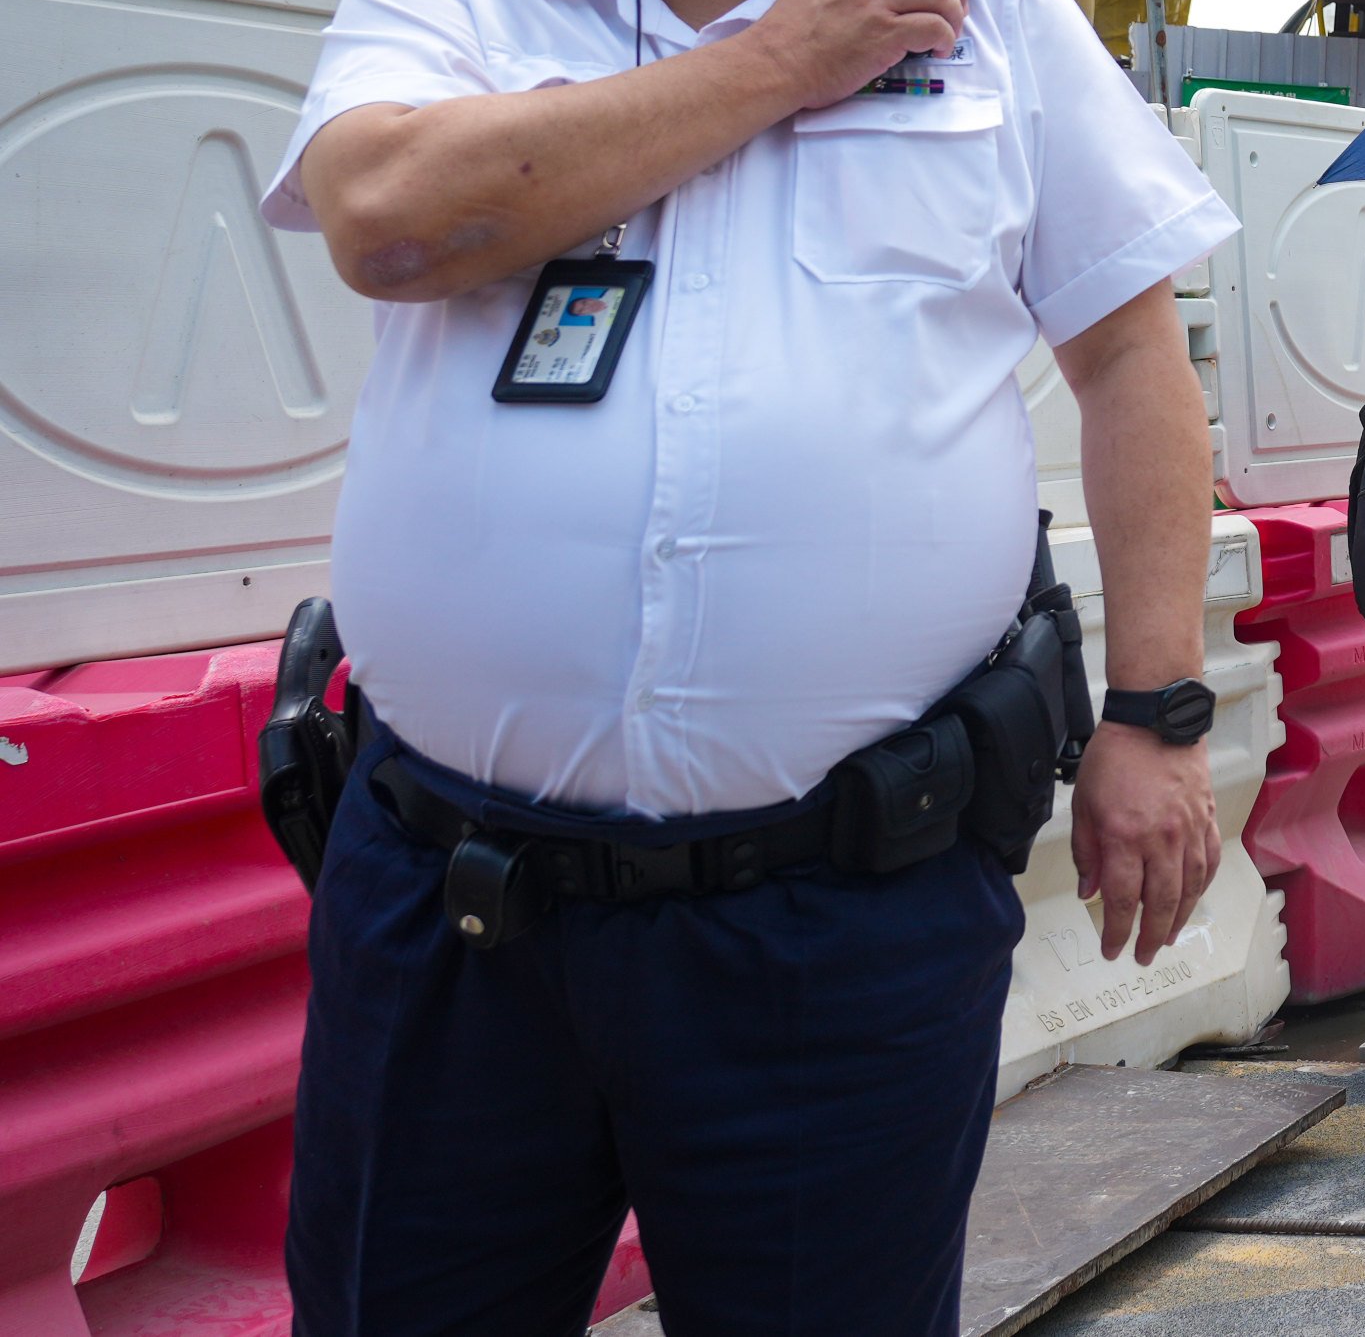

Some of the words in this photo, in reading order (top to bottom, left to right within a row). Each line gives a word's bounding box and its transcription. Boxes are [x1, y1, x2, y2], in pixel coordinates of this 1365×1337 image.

[1038, 926, 1095, 973] T2
[1036, 1008, 1066, 1032] BS
[1065, 997, 1094, 1023] EN
[1095, 960, 1194, 1012] 1317-2:2010
